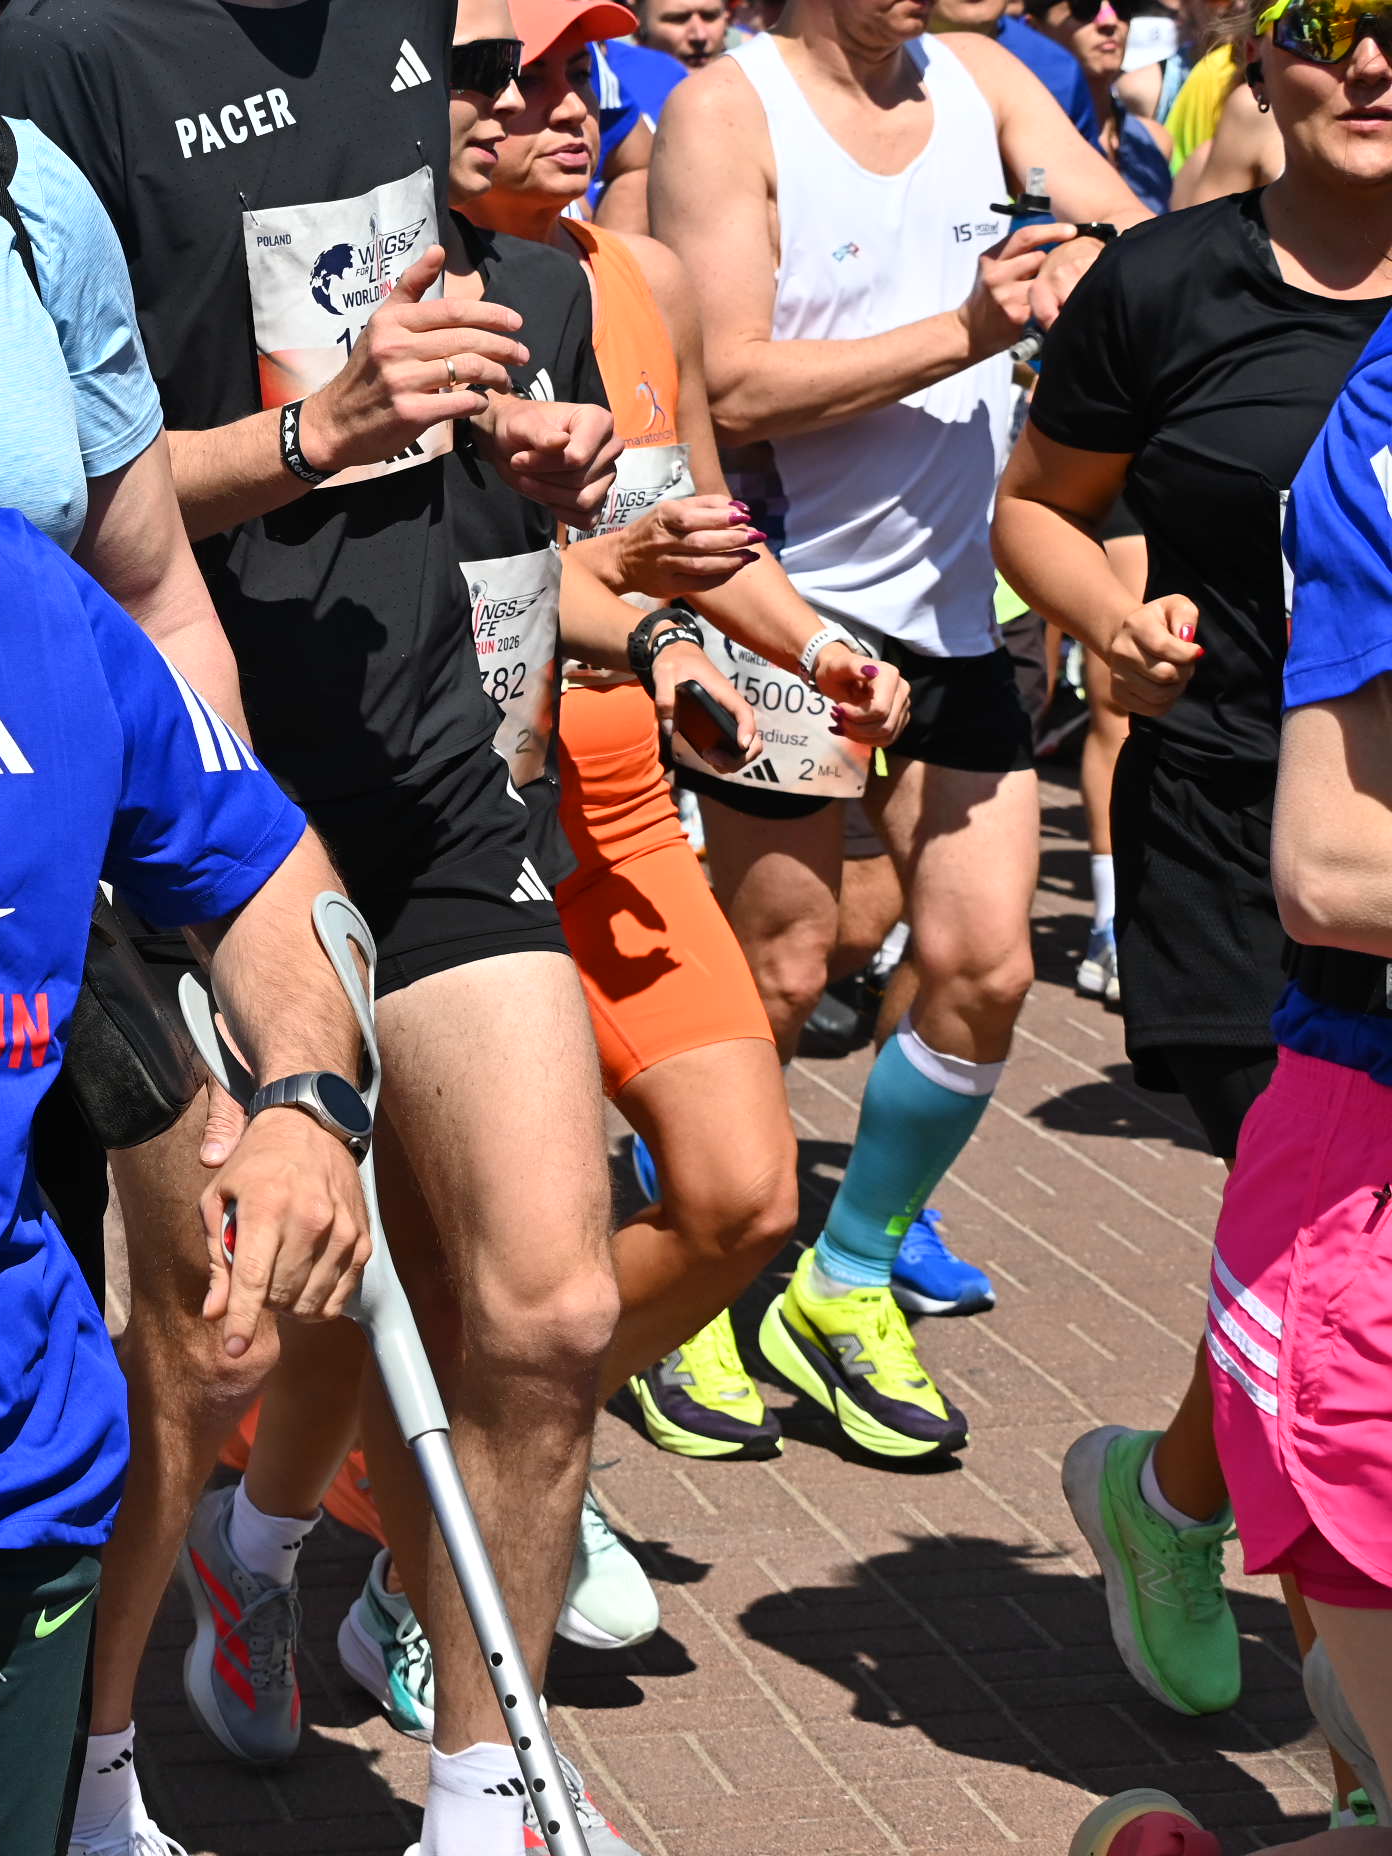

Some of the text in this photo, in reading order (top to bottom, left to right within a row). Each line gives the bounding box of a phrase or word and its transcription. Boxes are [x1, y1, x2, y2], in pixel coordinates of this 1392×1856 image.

[175, 88, 297, 159] PACER
[257, 234, 292, 247] POLAND
[953, 224, 972, 243] 15
[358, 232, 407, 265] WINGS
[369, 256, 393, 284] LIFE
[471, 600, 517, 621] INGS
[475, 635, 520, 655] RUN 2026
[729, 672, 826, 715] 15003
[515, 728, 532, 754] 2
[756, 728, 809, 747] adiusz
[798, 759, 841, 781] 2 M-L
